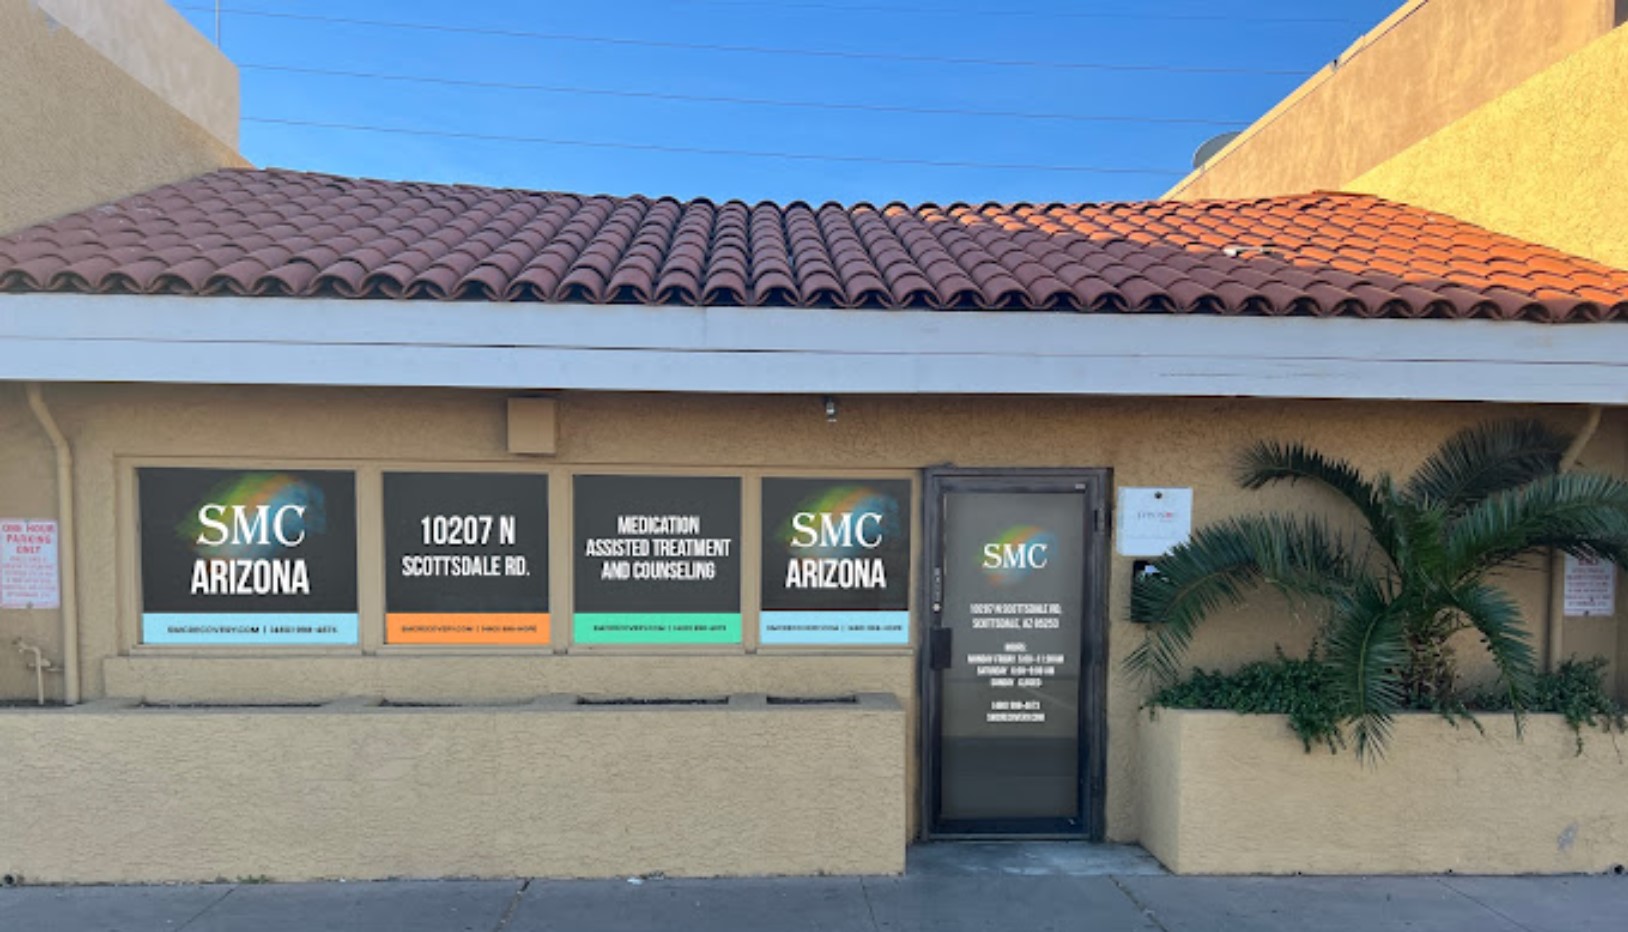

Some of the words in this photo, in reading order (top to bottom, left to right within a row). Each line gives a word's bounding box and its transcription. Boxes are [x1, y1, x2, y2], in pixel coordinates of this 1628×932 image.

[196, 504, 307, 547] SMC
[421, 515, 494, 545] 10207
[499, 515, 516, 545] N
[617, 515, 700, 535] MEDICATION
[791, 511, 883, 548] SMC
[6, 534, 51, 545] PARKING
[585, 538, 650, 557] ASSISTED
[652, 538, 731, 557] TREATMENT
[402, 555, 502, 577] SCOTTSDALE
[505, 555, 531, 577] RD.
[982, 543, 1049, 569] SMC
[191, 559, 310, 595] ARIZONA
[601, 560, 631, 580] AND
[633, 560, 716, 580] COUNSELING
[785, 557, 887, 589] ARIZONA
[1000, 603, 1048, 614] SCOTTSDALE
[1022, 617, 1033, 628] AZ
